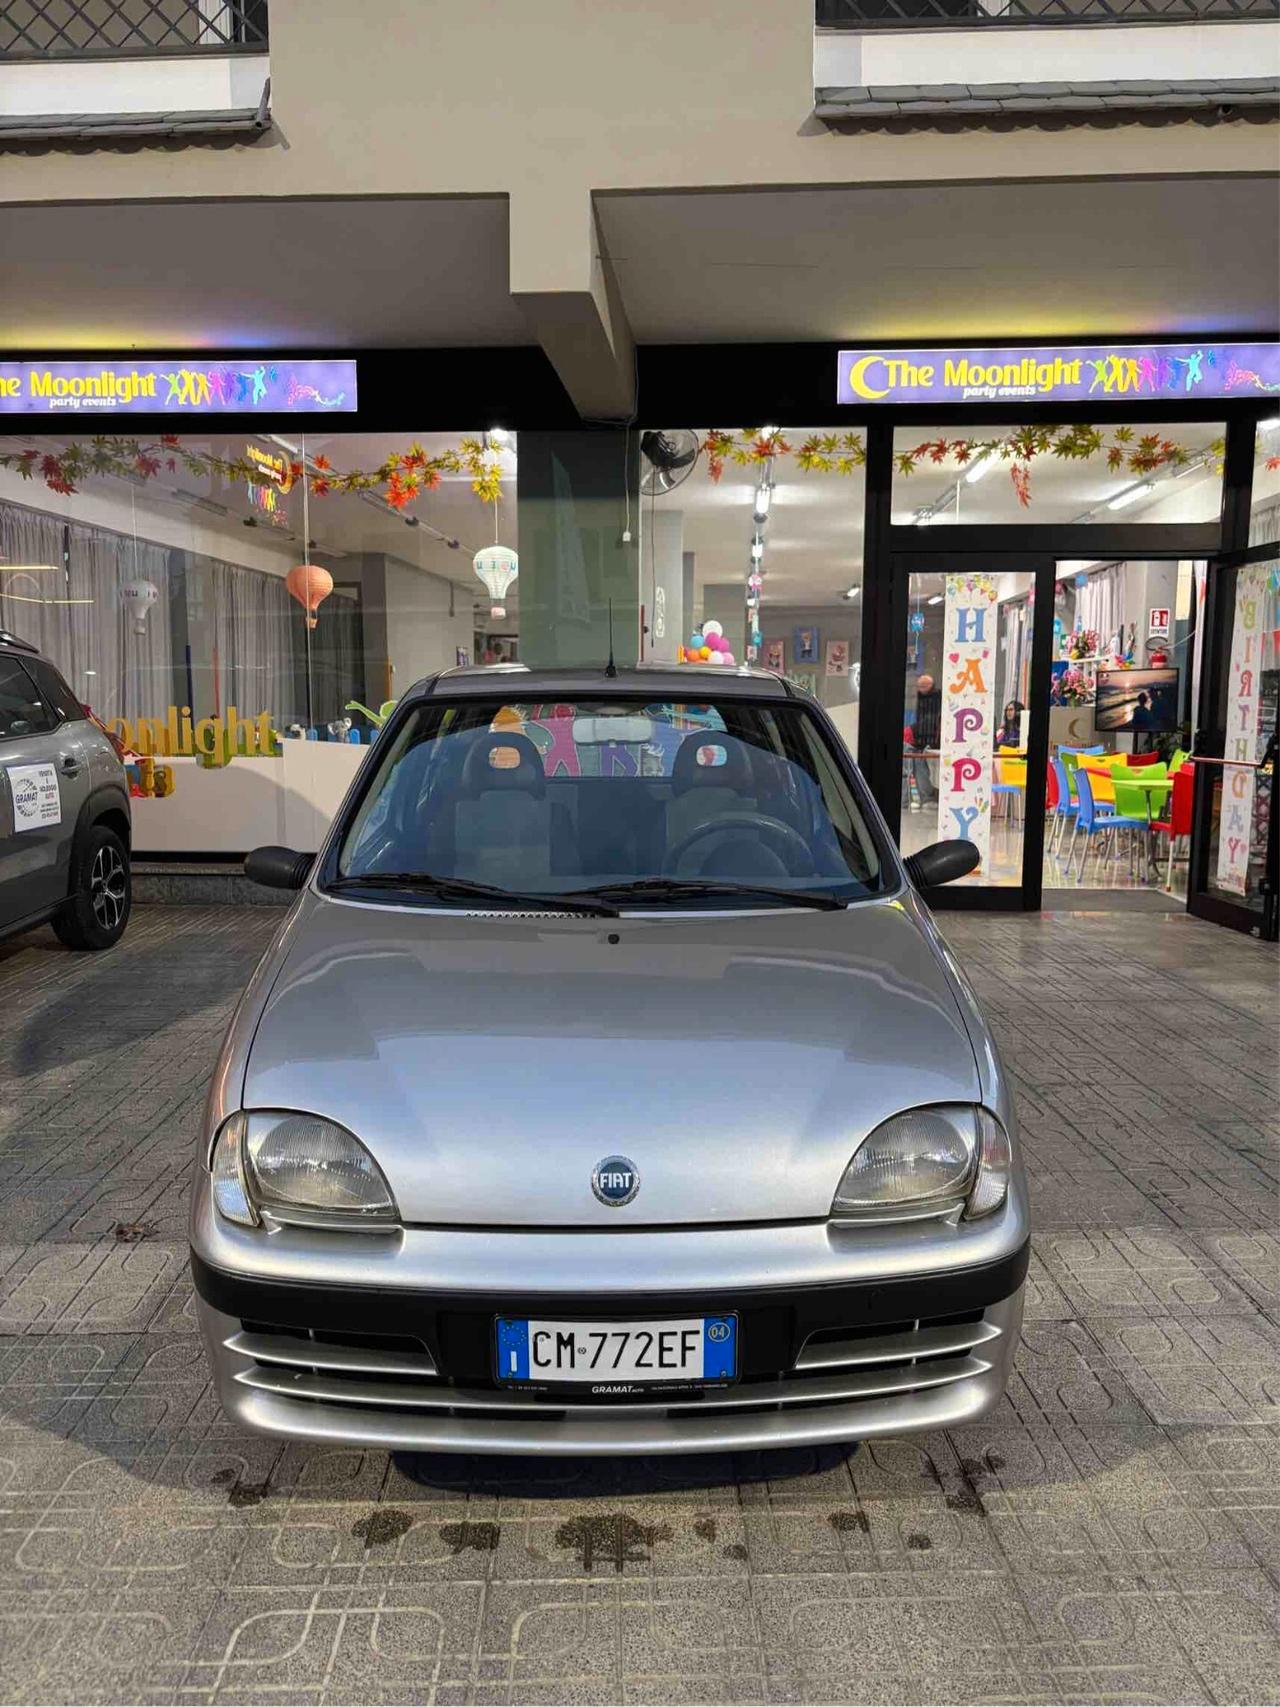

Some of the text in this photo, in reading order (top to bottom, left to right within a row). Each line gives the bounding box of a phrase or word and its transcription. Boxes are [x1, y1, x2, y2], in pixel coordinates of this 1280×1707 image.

[884, 358, 1083, 392] The Moonlight
[30, 371, 157, 403] Moonlight
[963, 385, 1036, 398] party events
[50, 397, 116, 408] party events
[949, 607, 989, 841] HAPPY
[108, 706, 275, 769] onlight
[16, 792, 38, 804] GRAMAT
[600, 1172, 632, 1189] FIAT
[710, 1324, 725, 1338] 04
